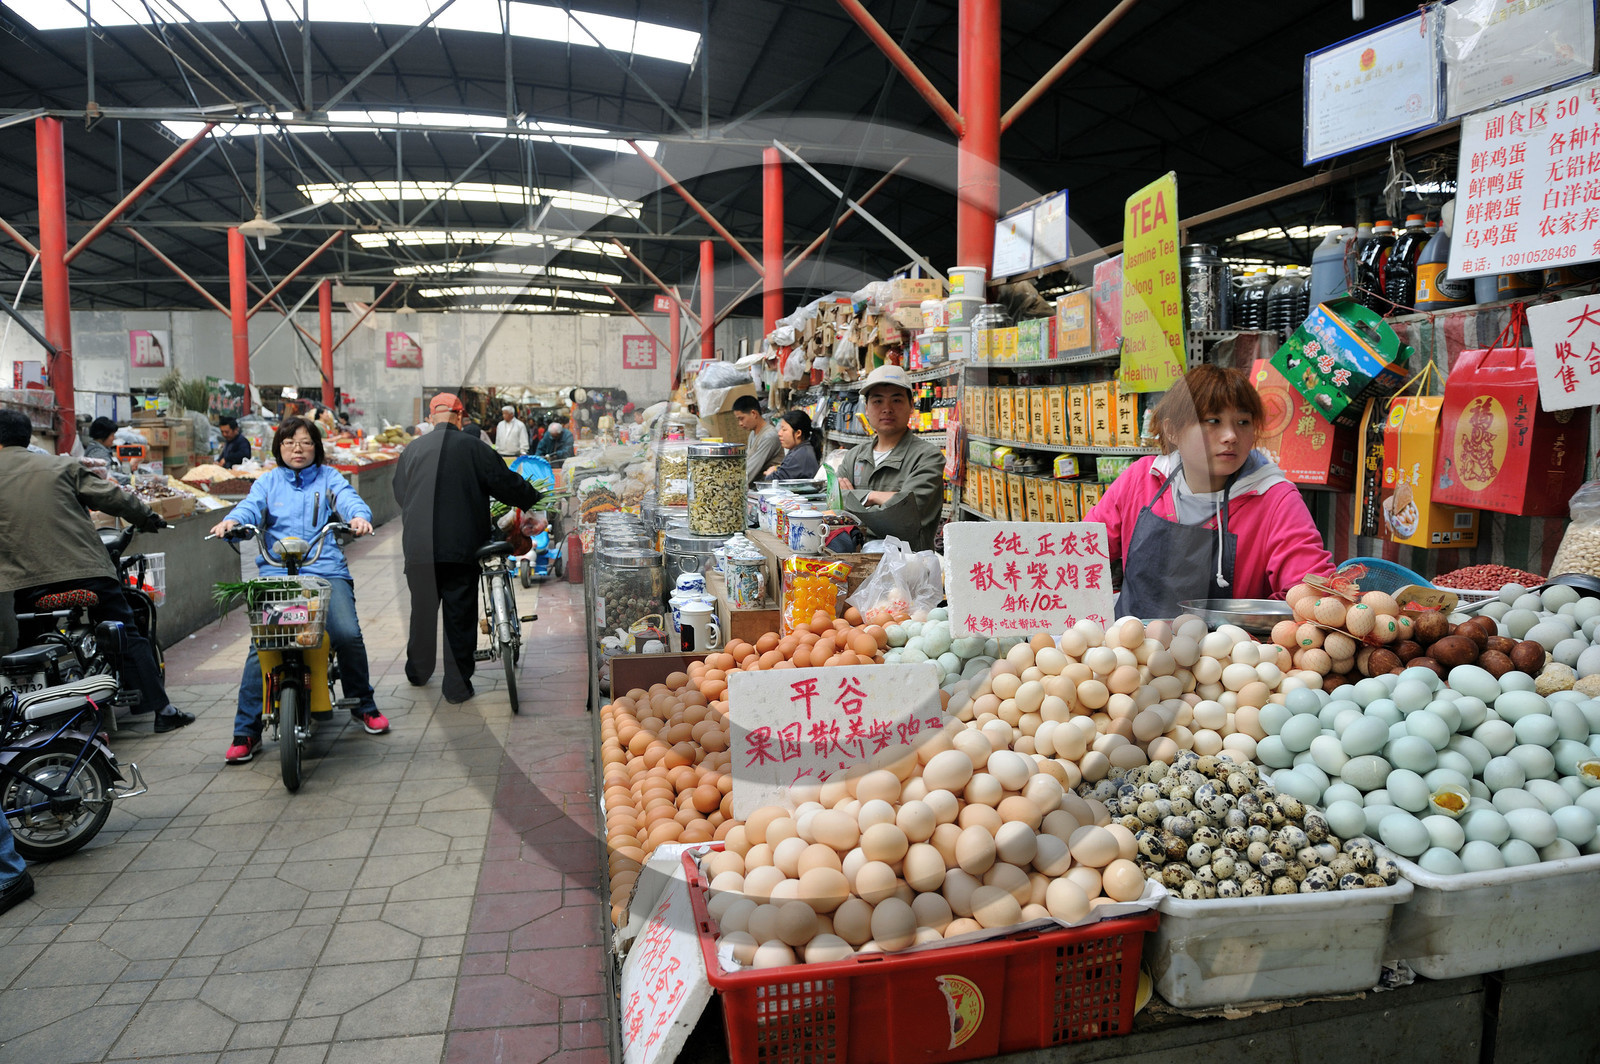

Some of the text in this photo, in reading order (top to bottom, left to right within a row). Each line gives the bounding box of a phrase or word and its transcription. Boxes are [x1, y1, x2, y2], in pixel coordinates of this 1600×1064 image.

[1484, 102, 1549, 141] 副食区
[1556, 95, 1580, 120] 50
[1470, 141, 1527, 174] 鲜鸡蛋
[1468, 168, 1524, 200] 鲜鸭蛋
[1130, 190, 1168, 239] TEA
[1465, 195, 1522, 225] 鲜鹅蛋
[1537, 206, 1600, 238] 农家养
[1463, 221, 1518, 249] 乌鸡蛋
[1125, 239, 1175, 271] Jasmine Tea
[1500, 244, 1577, 268] 13910528436
[1125, 277, 1153, 299] Oolong
[1159, 269, 1176, 288] Tea
[1124, 300, 1178, 327] Green Tea
[626, 339, 653, 367] 鞋
[1124, 330, 1181, 354] Black Tea
[1123, 360, 1183, 383] Healthy Tea
[993, 530, 1110, 560] 纯正农家
[969, 560, 1104, 592] 散养柴鸡蛋
[789, 676, 869, 721] 平谷
